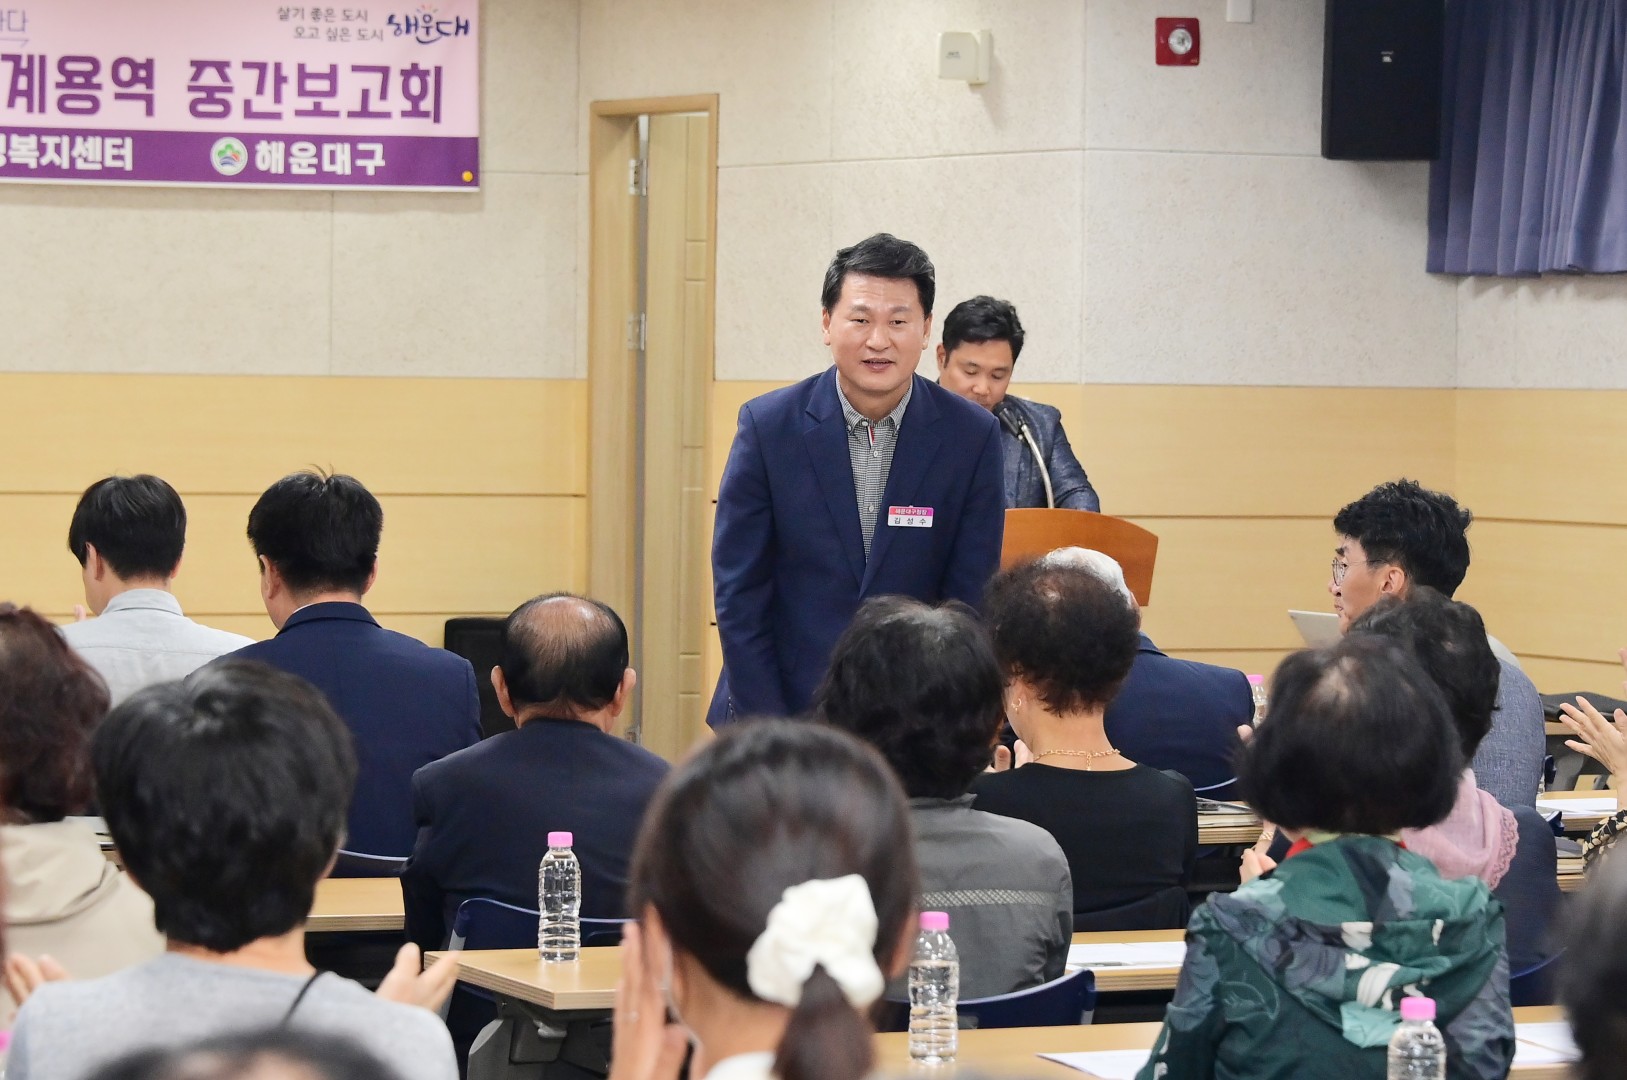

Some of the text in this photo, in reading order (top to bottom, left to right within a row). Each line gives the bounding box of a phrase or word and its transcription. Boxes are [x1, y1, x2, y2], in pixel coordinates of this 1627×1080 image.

[277, 6, 369, 23] 살기 좋은 도시
[386, 13, 470, 44] 해운대
[293, 26, 384, 42] 오고 싶은 도시
[0, 53, 442, 124] 계용역 중간보고회
[254, 141, 386, 176] 해운대구
